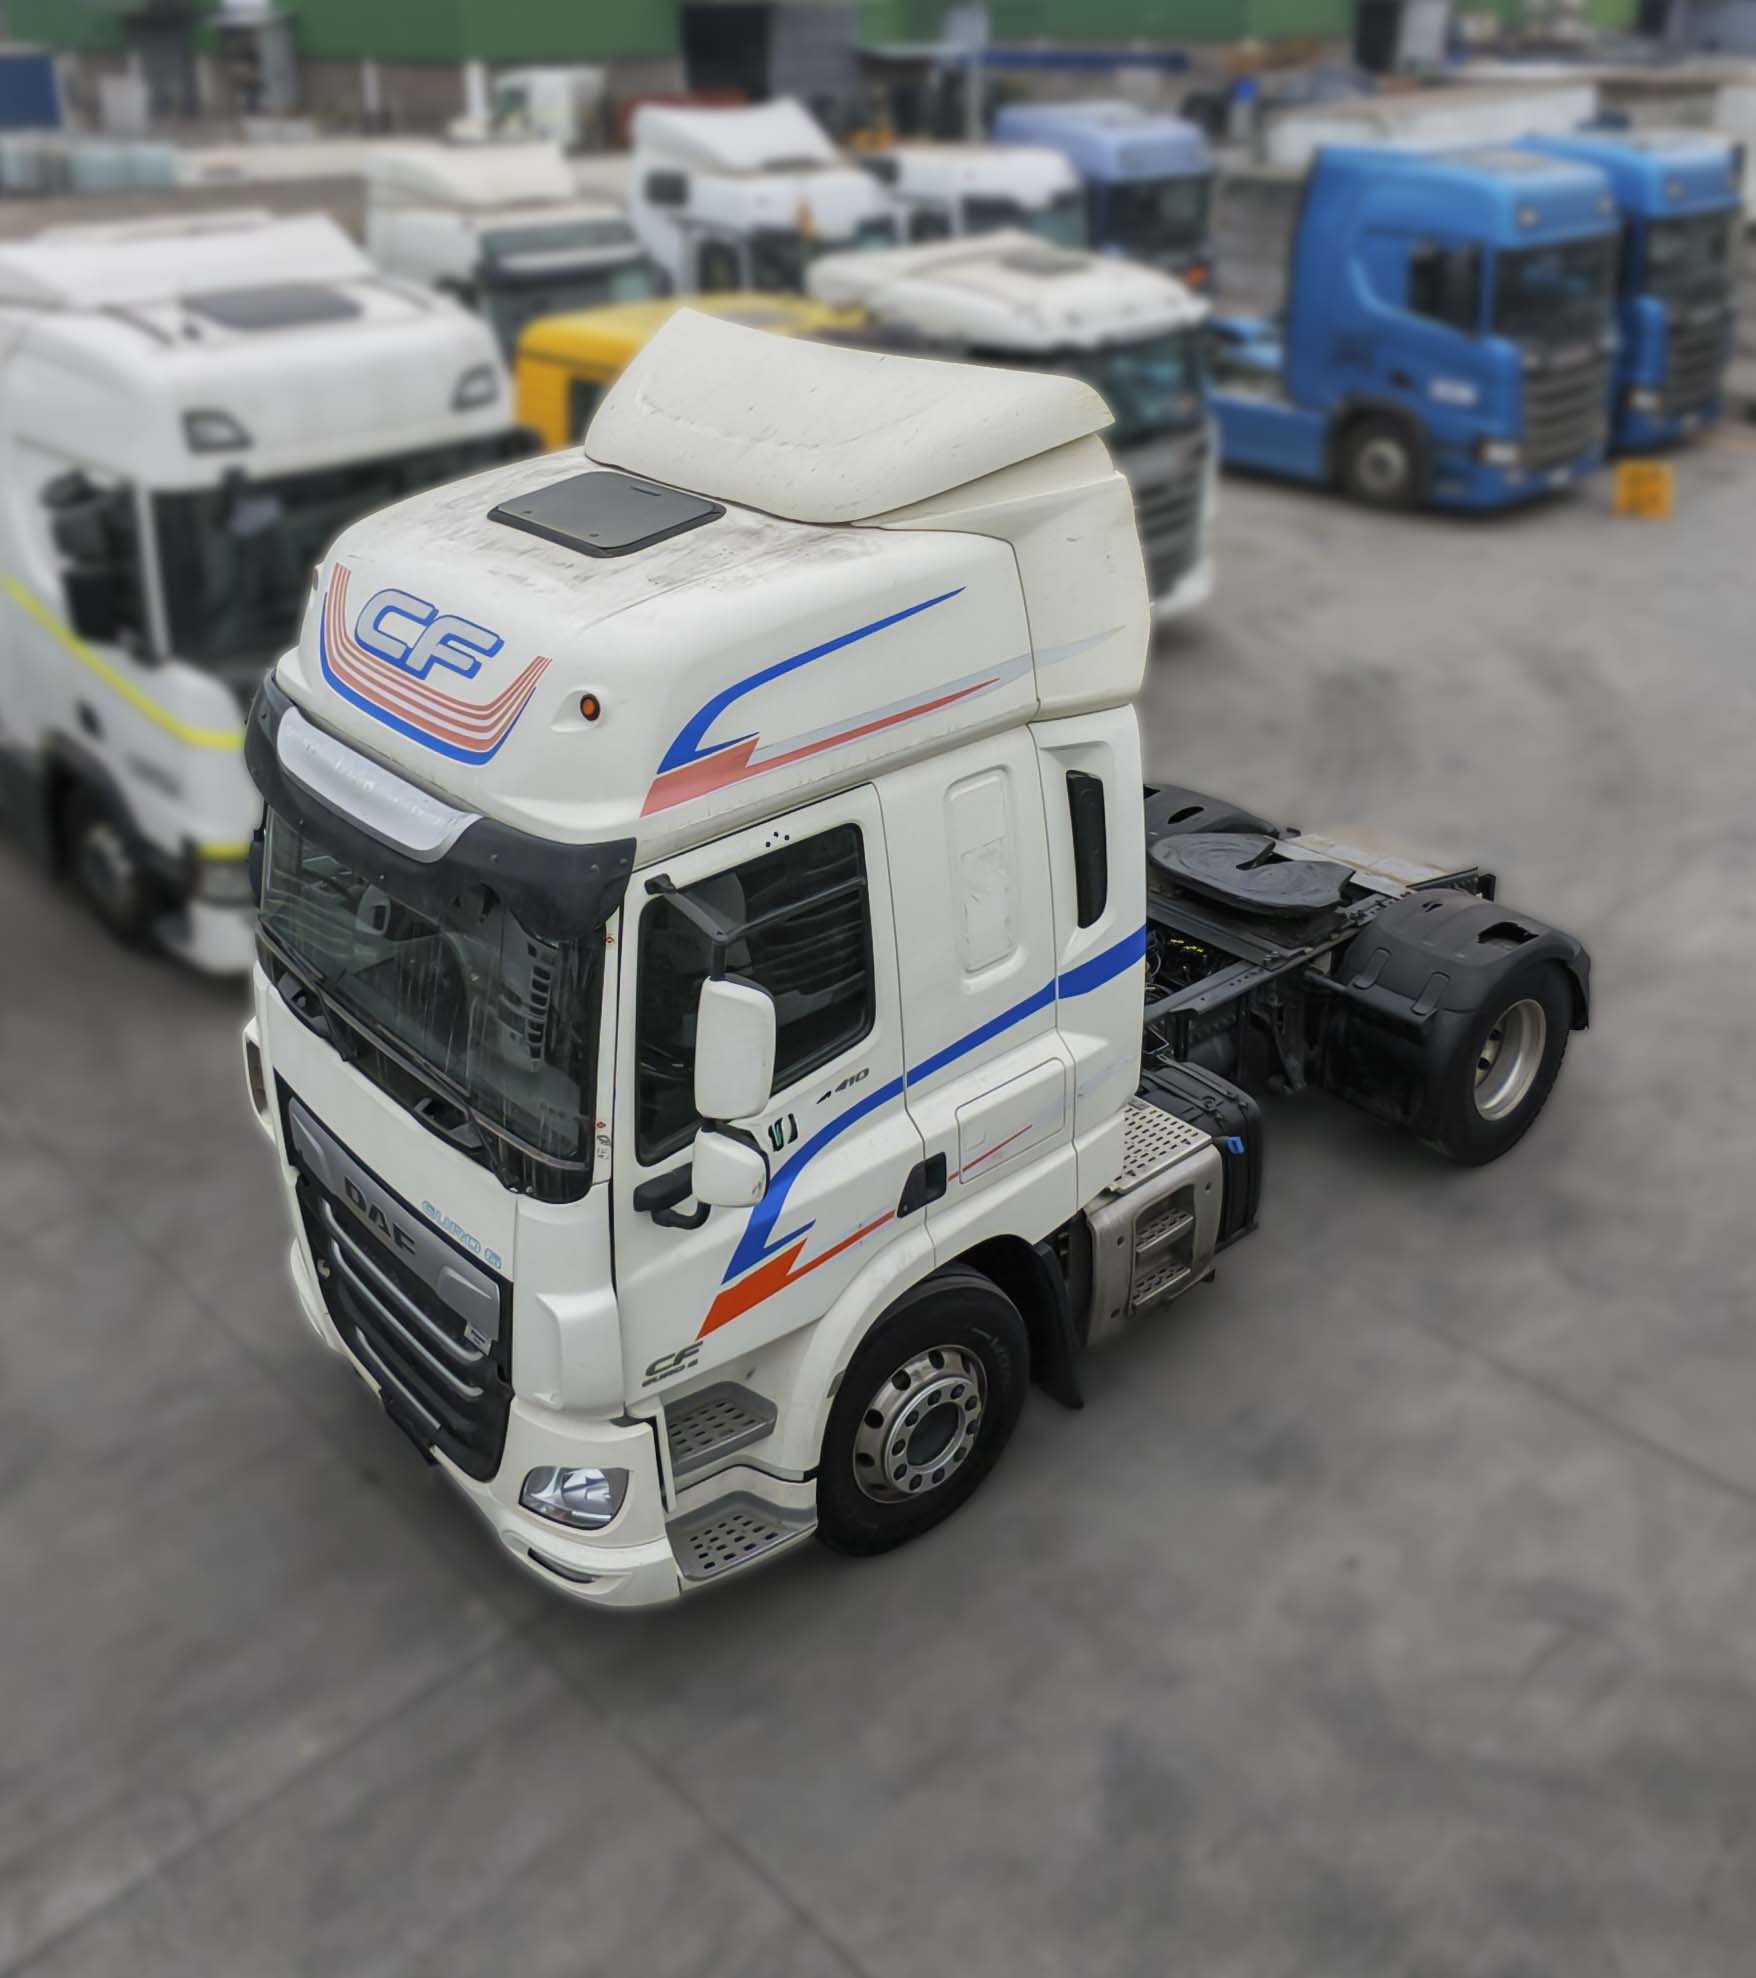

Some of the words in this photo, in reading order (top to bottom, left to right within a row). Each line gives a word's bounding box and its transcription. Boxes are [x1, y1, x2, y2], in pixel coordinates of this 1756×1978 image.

[354, 588, 505, 681] CF
[835, 1067, 869, 1092] 410
[344, 1176, 416, 1255] DAF
[645, 1341, 704, 1376] CF
